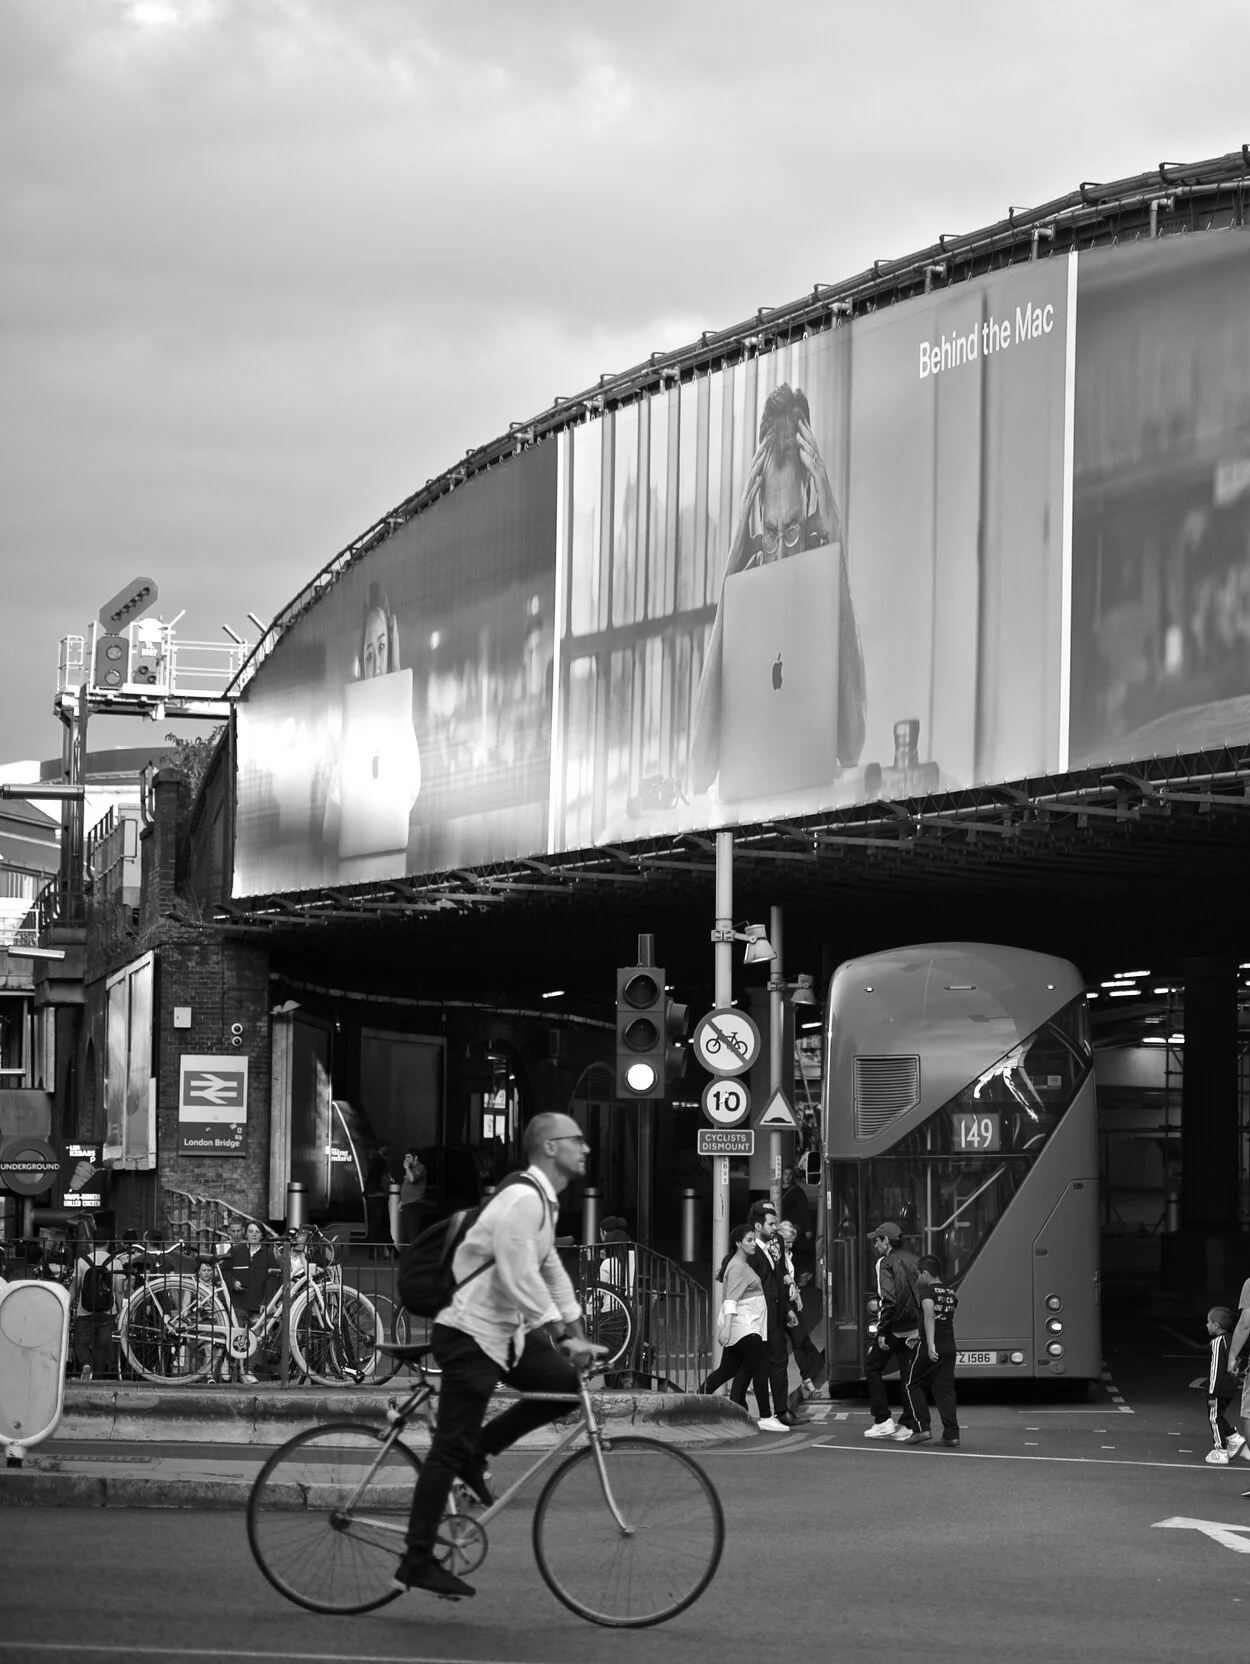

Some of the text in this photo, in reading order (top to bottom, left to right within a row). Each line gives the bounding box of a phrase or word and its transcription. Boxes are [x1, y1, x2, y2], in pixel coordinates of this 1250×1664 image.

[919, 301, 1054, 379] Behind the Mac
[713, 1091, 741, 1112] 10
[705, 1133, 746, 1142] CYCLISTS
[961, 1118, 992, 1148] 149
[184, 1138, 240, 1149] London Bridge
[702, 1143, 750, 1151] DISMOUNT
[0, 1163, 61, 1171] UNDERGROUND
